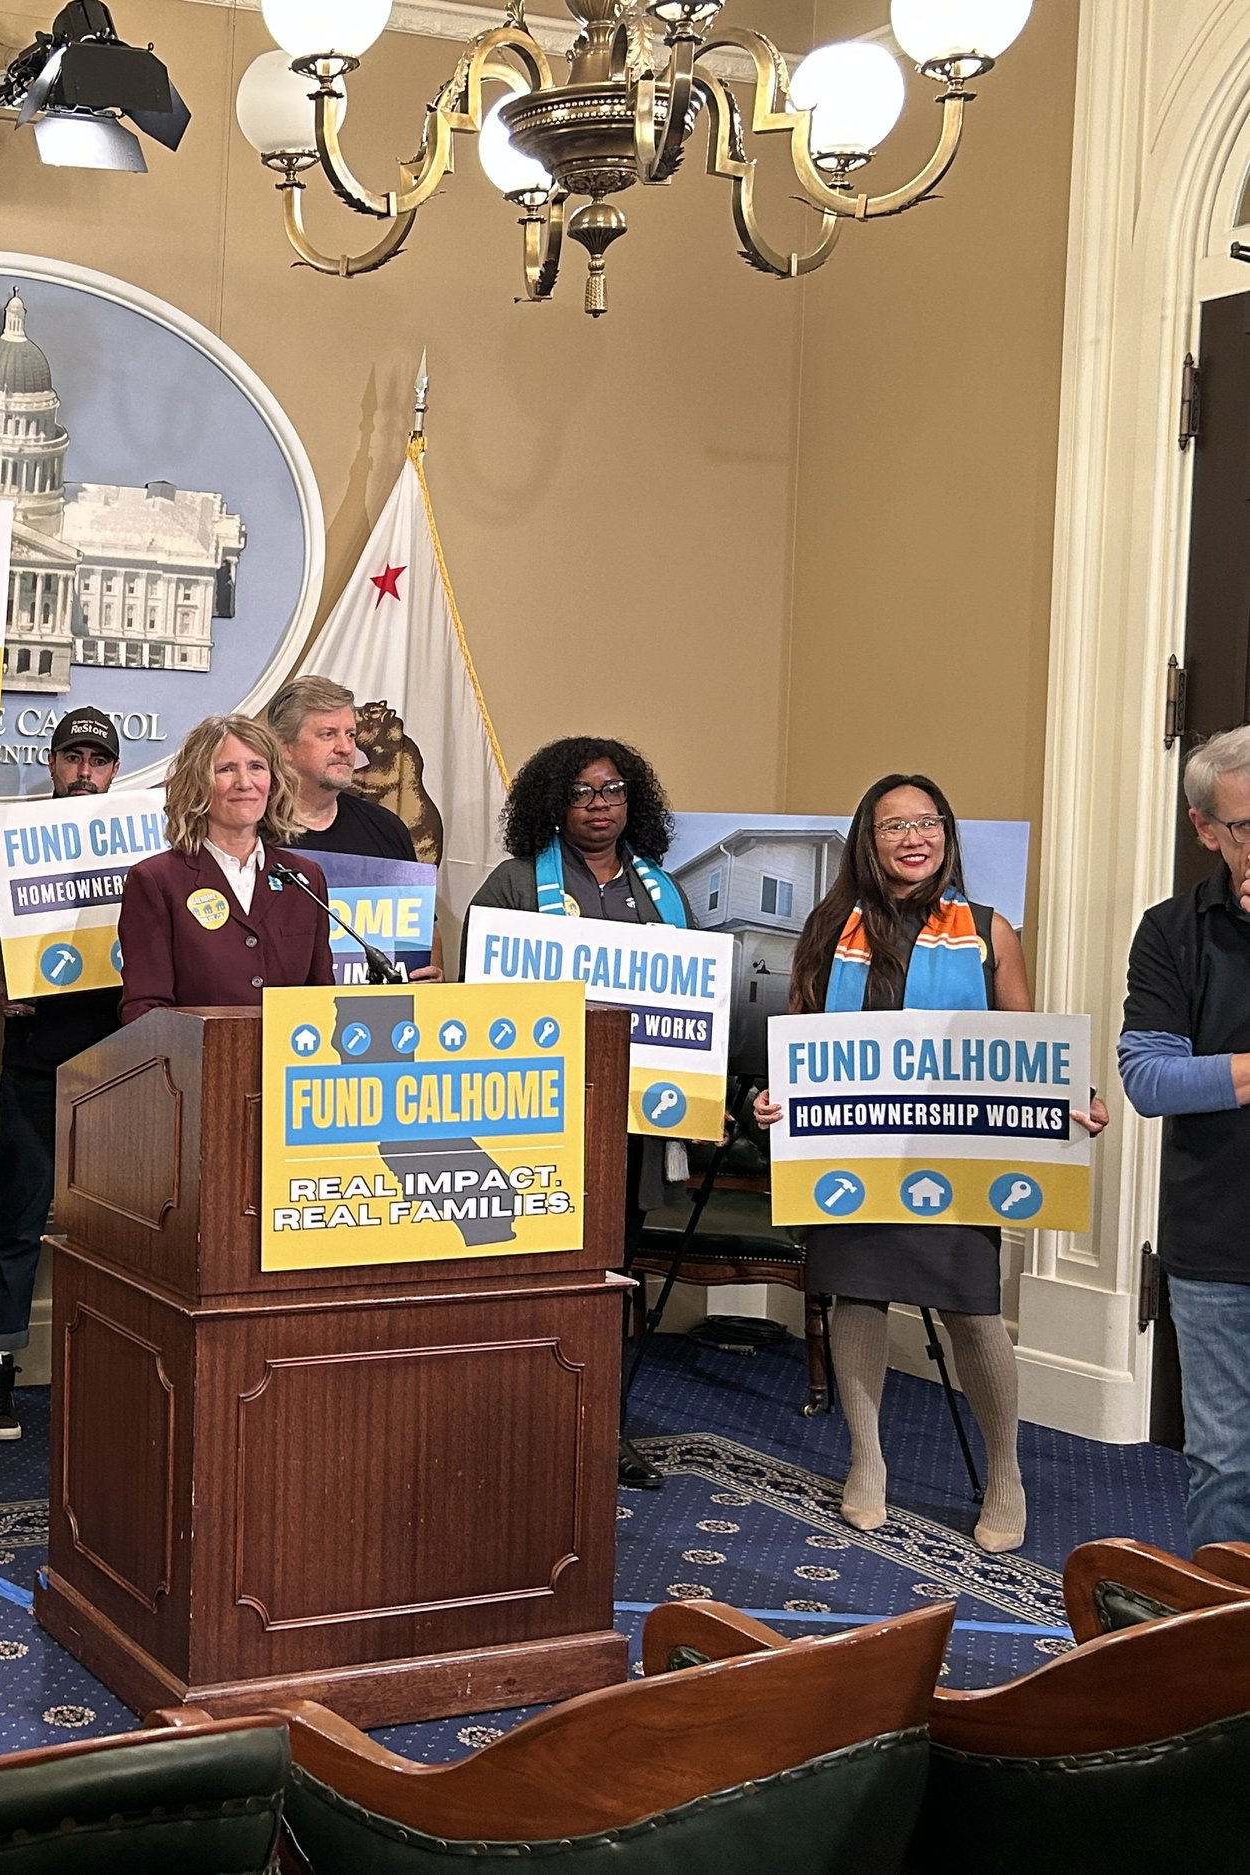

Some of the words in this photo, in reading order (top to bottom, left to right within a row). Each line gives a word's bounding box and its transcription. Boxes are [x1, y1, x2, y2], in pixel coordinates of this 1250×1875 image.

[17, 708, 168, 741] CATOL
[4, 822, 82, 868] FUND
[89, 813, 171, 857] CALH
[17, 873, 128, 907] HOMEOWNER
[483, 934, 564, 981] FUND
[572, 943, 717, 999] CALHOME
[645, 1014, 707, 1042] WORKS
[788, 1039, 881, 1085] FUND
[893, 1038, 1071, 1086] CALHOME
[291, 1076, 383, 1130] FUND
[395, 1069, 560, 1125] CALHOME
[796, 1102, 979, 1128] HOMEOWNERSHIP
[986, 1104, 1063, 1131] WORKS
[289, 1174, 398, 1203] REAL
[404, 1165, 562, 1197] IMPACT.
[273, 1203, 382, 1232] REAL
[388, 1191, 576, 1226] FAMILIES.
